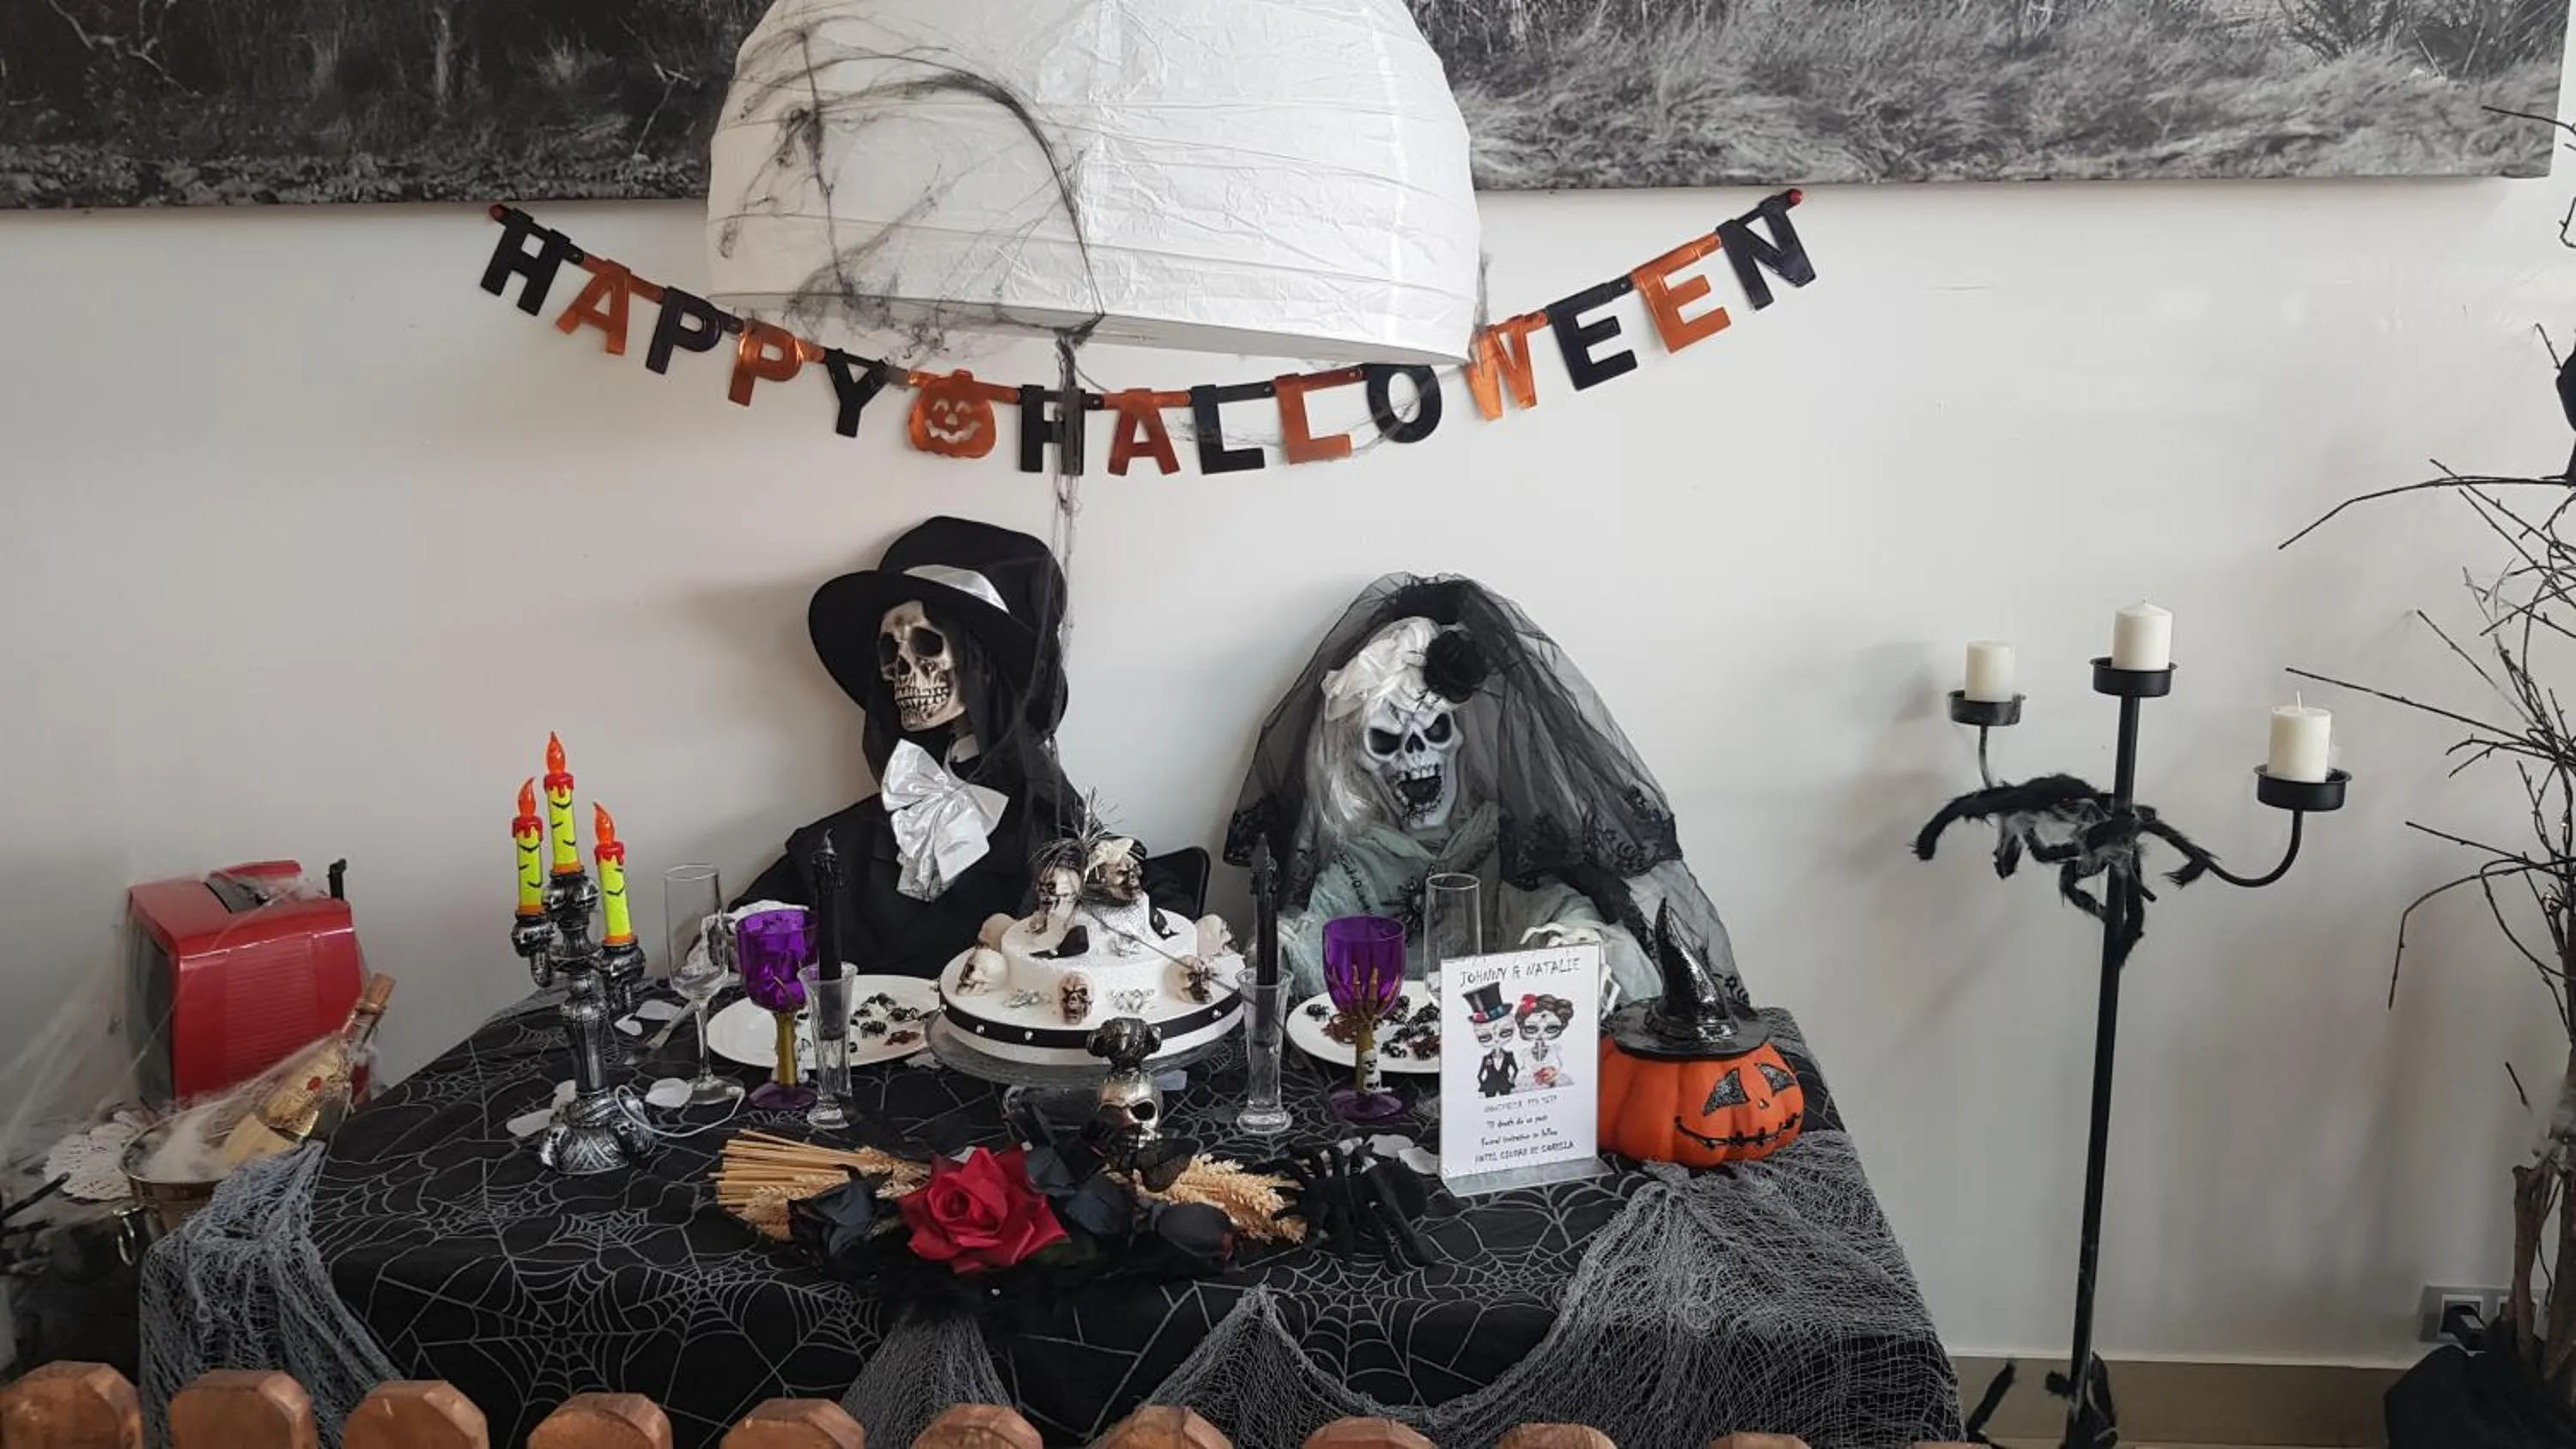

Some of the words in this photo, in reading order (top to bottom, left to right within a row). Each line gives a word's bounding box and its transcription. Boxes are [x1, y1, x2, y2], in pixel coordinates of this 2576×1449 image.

[479, 207, 891, 438] HAPPY
[1019, 194, 1816, 476] HALLOWEEN
[1459, 967, 1507, 988] JOHNNY
[1526, 957, 1581, 977] NATALIE
